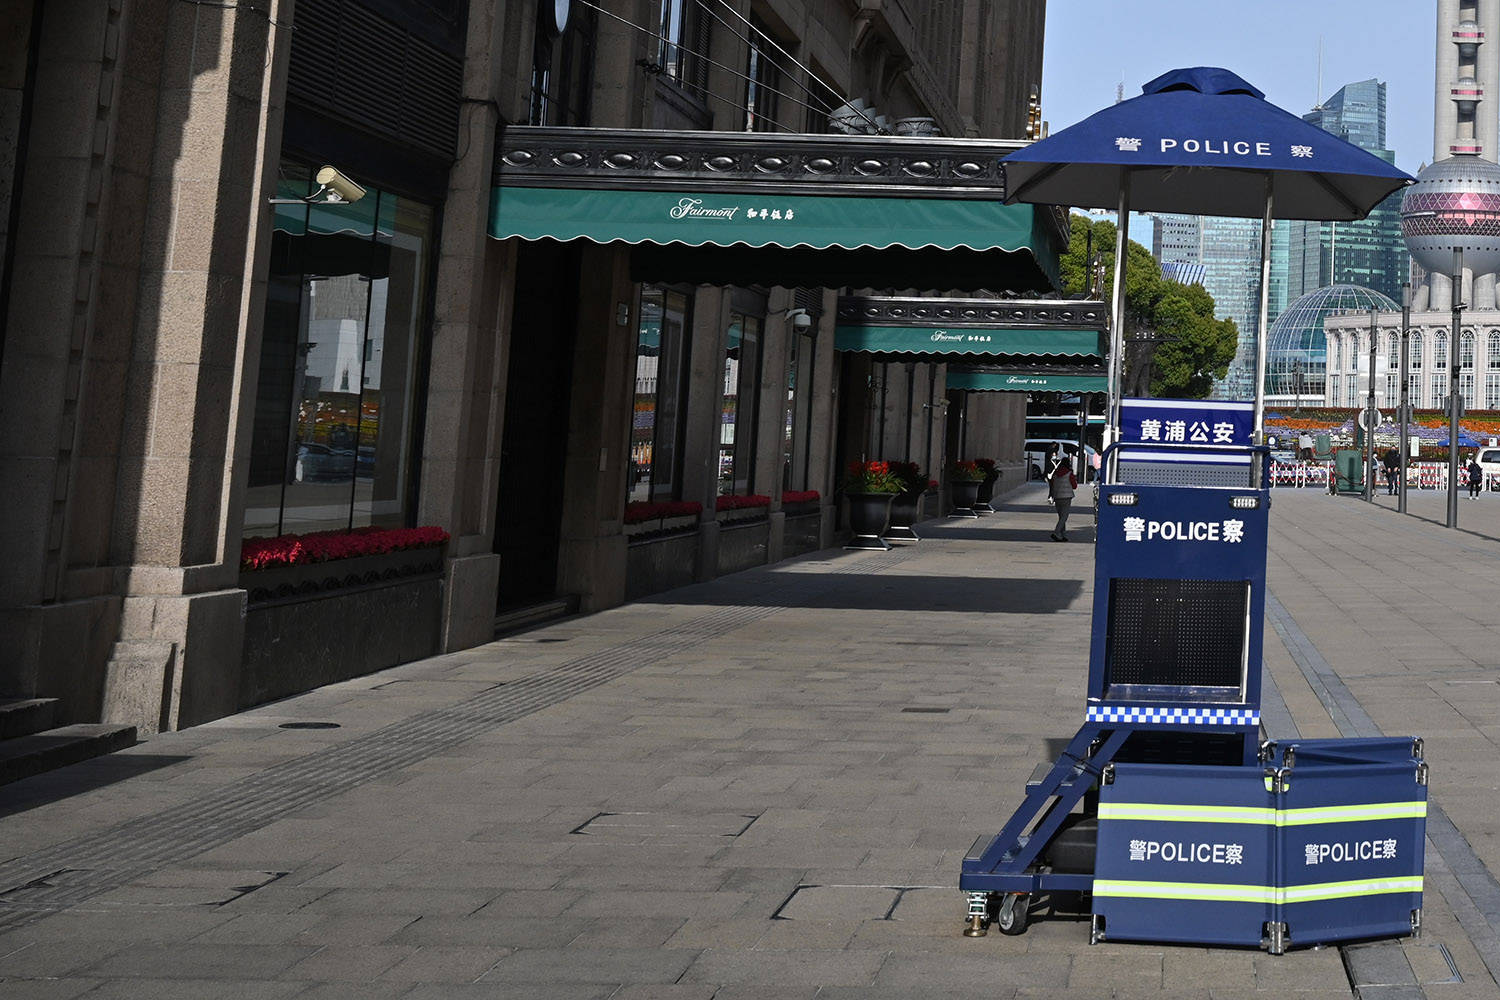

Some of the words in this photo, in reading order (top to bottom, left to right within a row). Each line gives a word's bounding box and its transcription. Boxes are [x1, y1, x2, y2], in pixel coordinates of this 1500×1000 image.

[1114, 136, 1142, 152] 警
[1160, 138, 1272, 156] POLICE
[1290, 144, 1314, 159] 察
[670, 197, 739, 220] Fairmont
[1140, 419, 1235, 444] 黄浦公安
